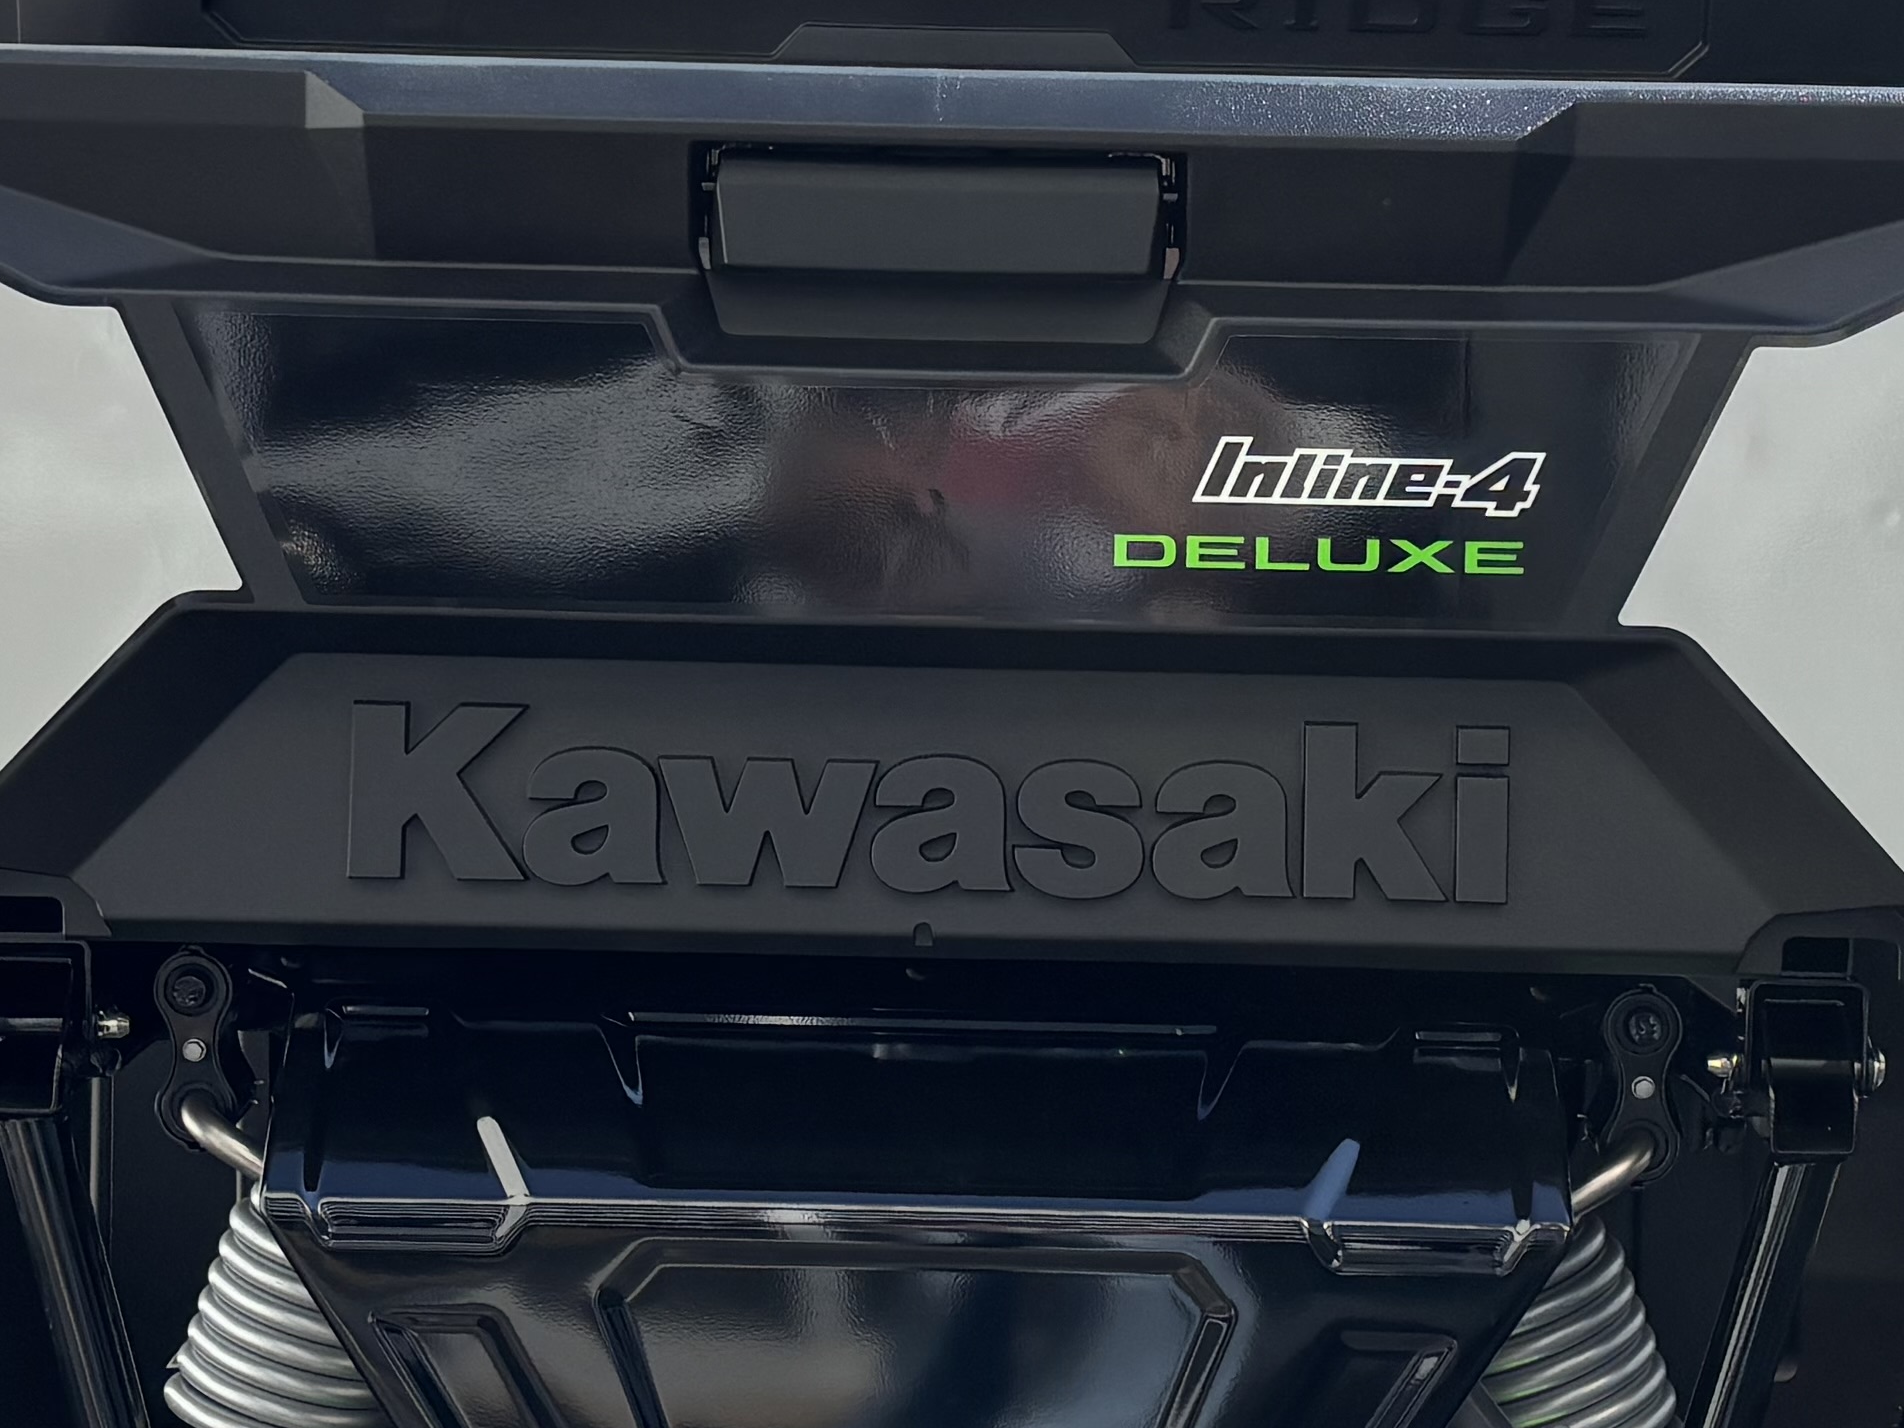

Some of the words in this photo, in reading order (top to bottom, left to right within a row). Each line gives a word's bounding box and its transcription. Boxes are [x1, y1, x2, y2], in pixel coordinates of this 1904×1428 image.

[1192, 436, 1546, 517] Inline-4
[1113, 534, 1524, 574] DELUXE
[347, 699, 1510, 904] Kawasaki
